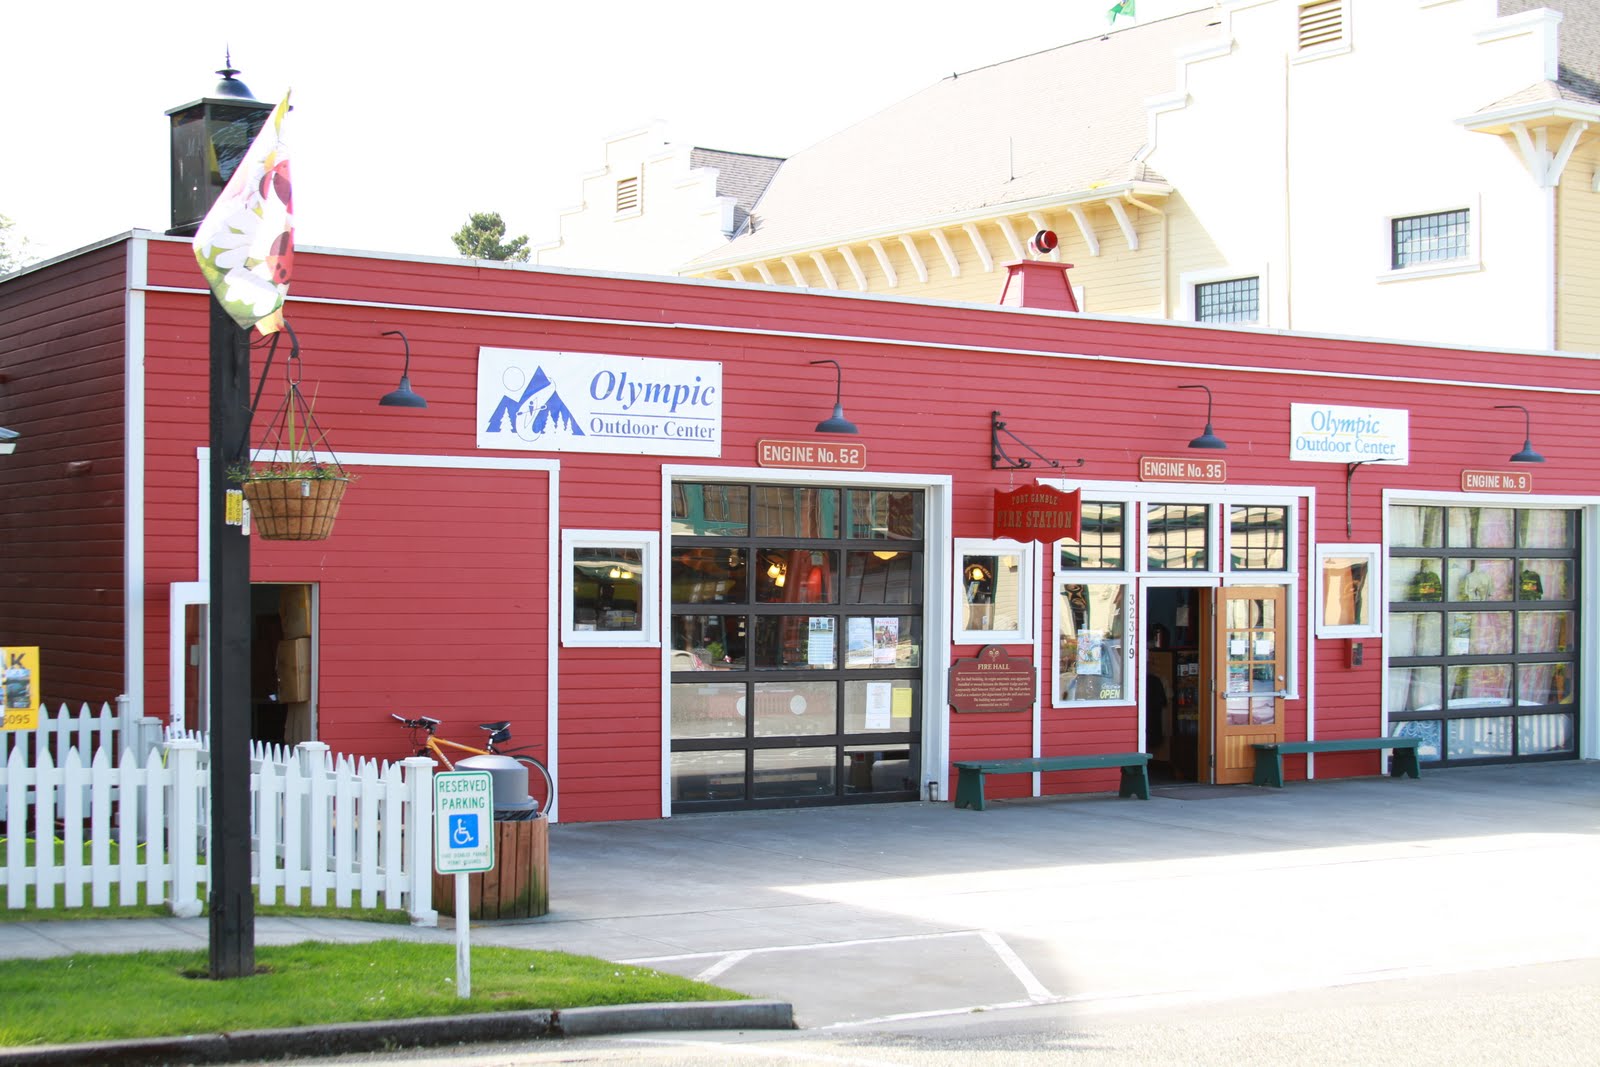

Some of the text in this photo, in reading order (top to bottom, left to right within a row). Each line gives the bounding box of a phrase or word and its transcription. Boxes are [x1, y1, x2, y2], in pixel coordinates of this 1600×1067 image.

[589, 370, 715, 413] Olympic
[590, 417, 715, 438] Outdoor Center
[1311, 410, 1380, 438] Olympic
[1295, 436, 1396, 454] Outdoor Center
[763, 445, 859, 464] ENGINE No. 52
[1144, 462, 1222, 479] ENGINE No. 35
[1466, 474, 1527, 489] ENGINE No. 9
[997, 510, 1073, 529] FIRE STATION
[1128, 594, 1136, 660] 32379
[1100, 689, 1121, 699] OPEN
[439, 780, 487, 793] RESERVED
[442, 797, 485, 809] PARKING
